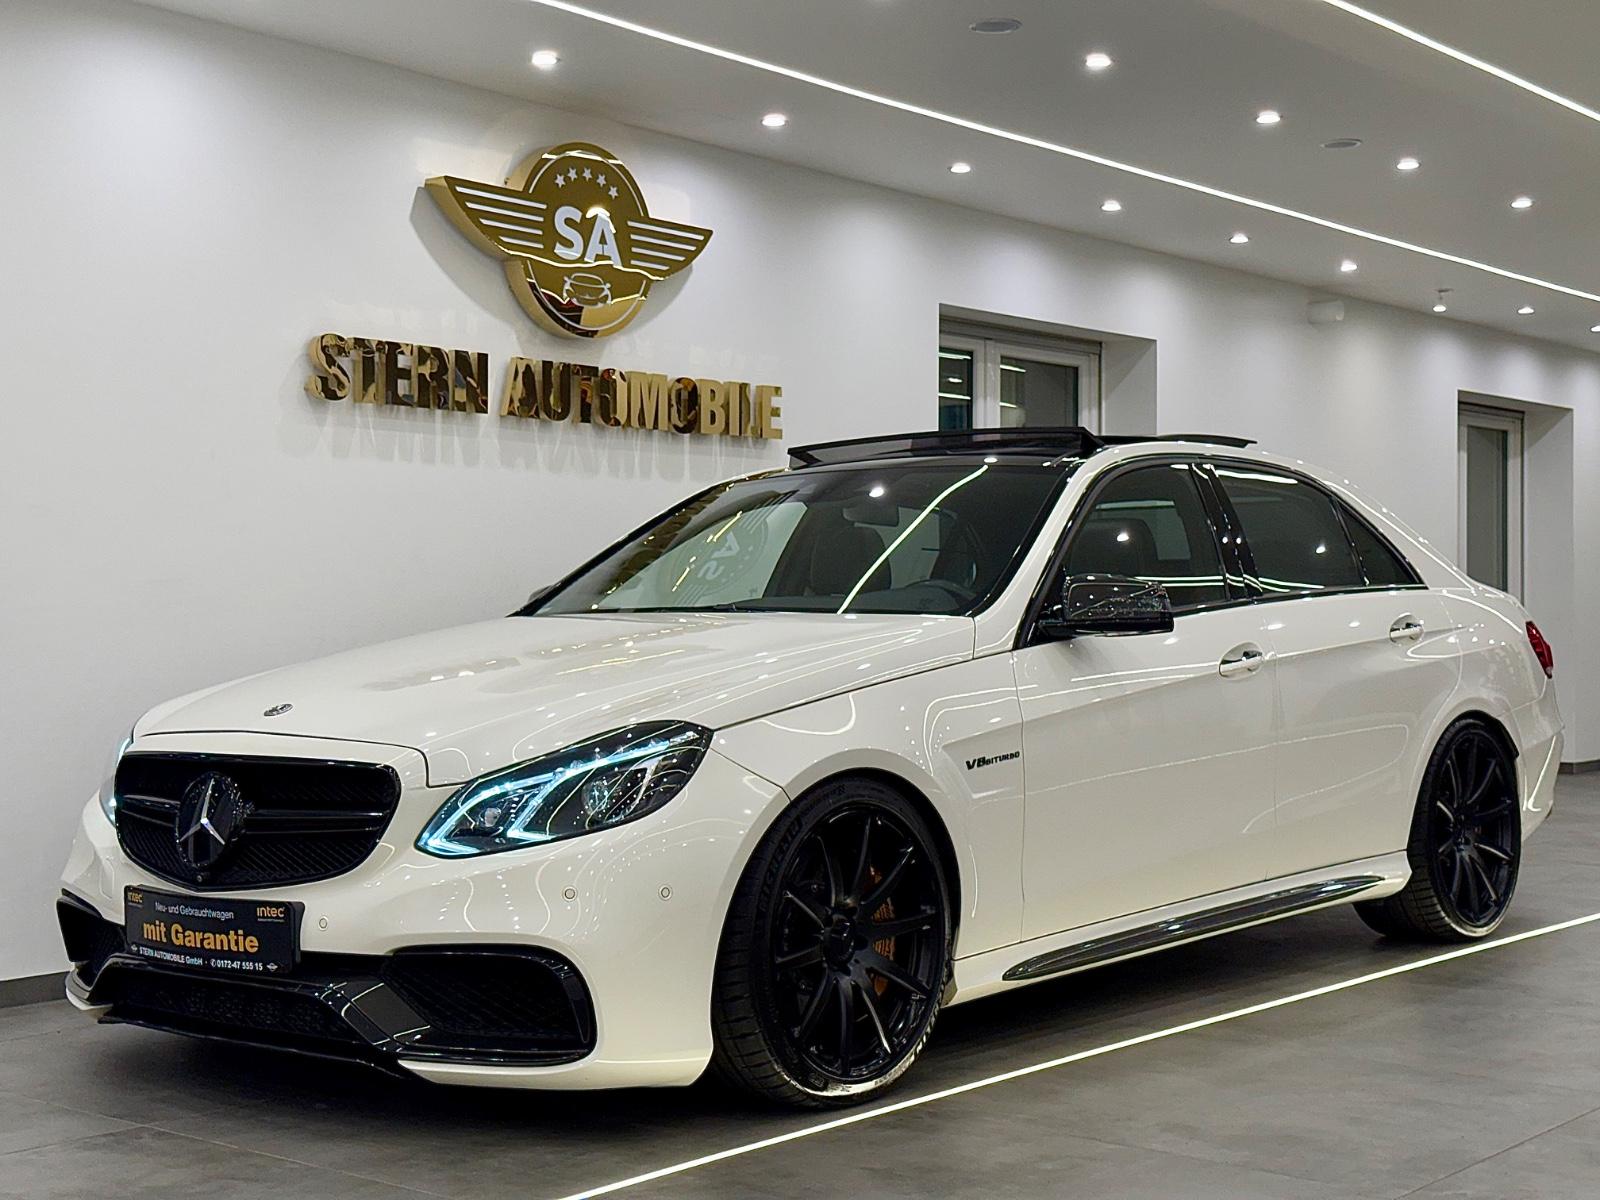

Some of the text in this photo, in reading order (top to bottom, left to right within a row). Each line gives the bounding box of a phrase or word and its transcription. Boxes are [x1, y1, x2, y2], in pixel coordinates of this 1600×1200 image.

[552, 205, 622, 268] SA
[305, 333, 783, 440] STERN AUTOMOBILE
[155, 901, 168, 913] Neu-
[168, 904, 179, 914] und
[180, 905, 234, 921] Gebrauchtwagen
[257, 906, 284, 918] intec
[143, 920, 259, 953] mit Garantie
[154, 949, 185, 963] AUTOMOBILE
[185, 955, 203, 965] GmbH
[255, 962, 263, 971] 15
